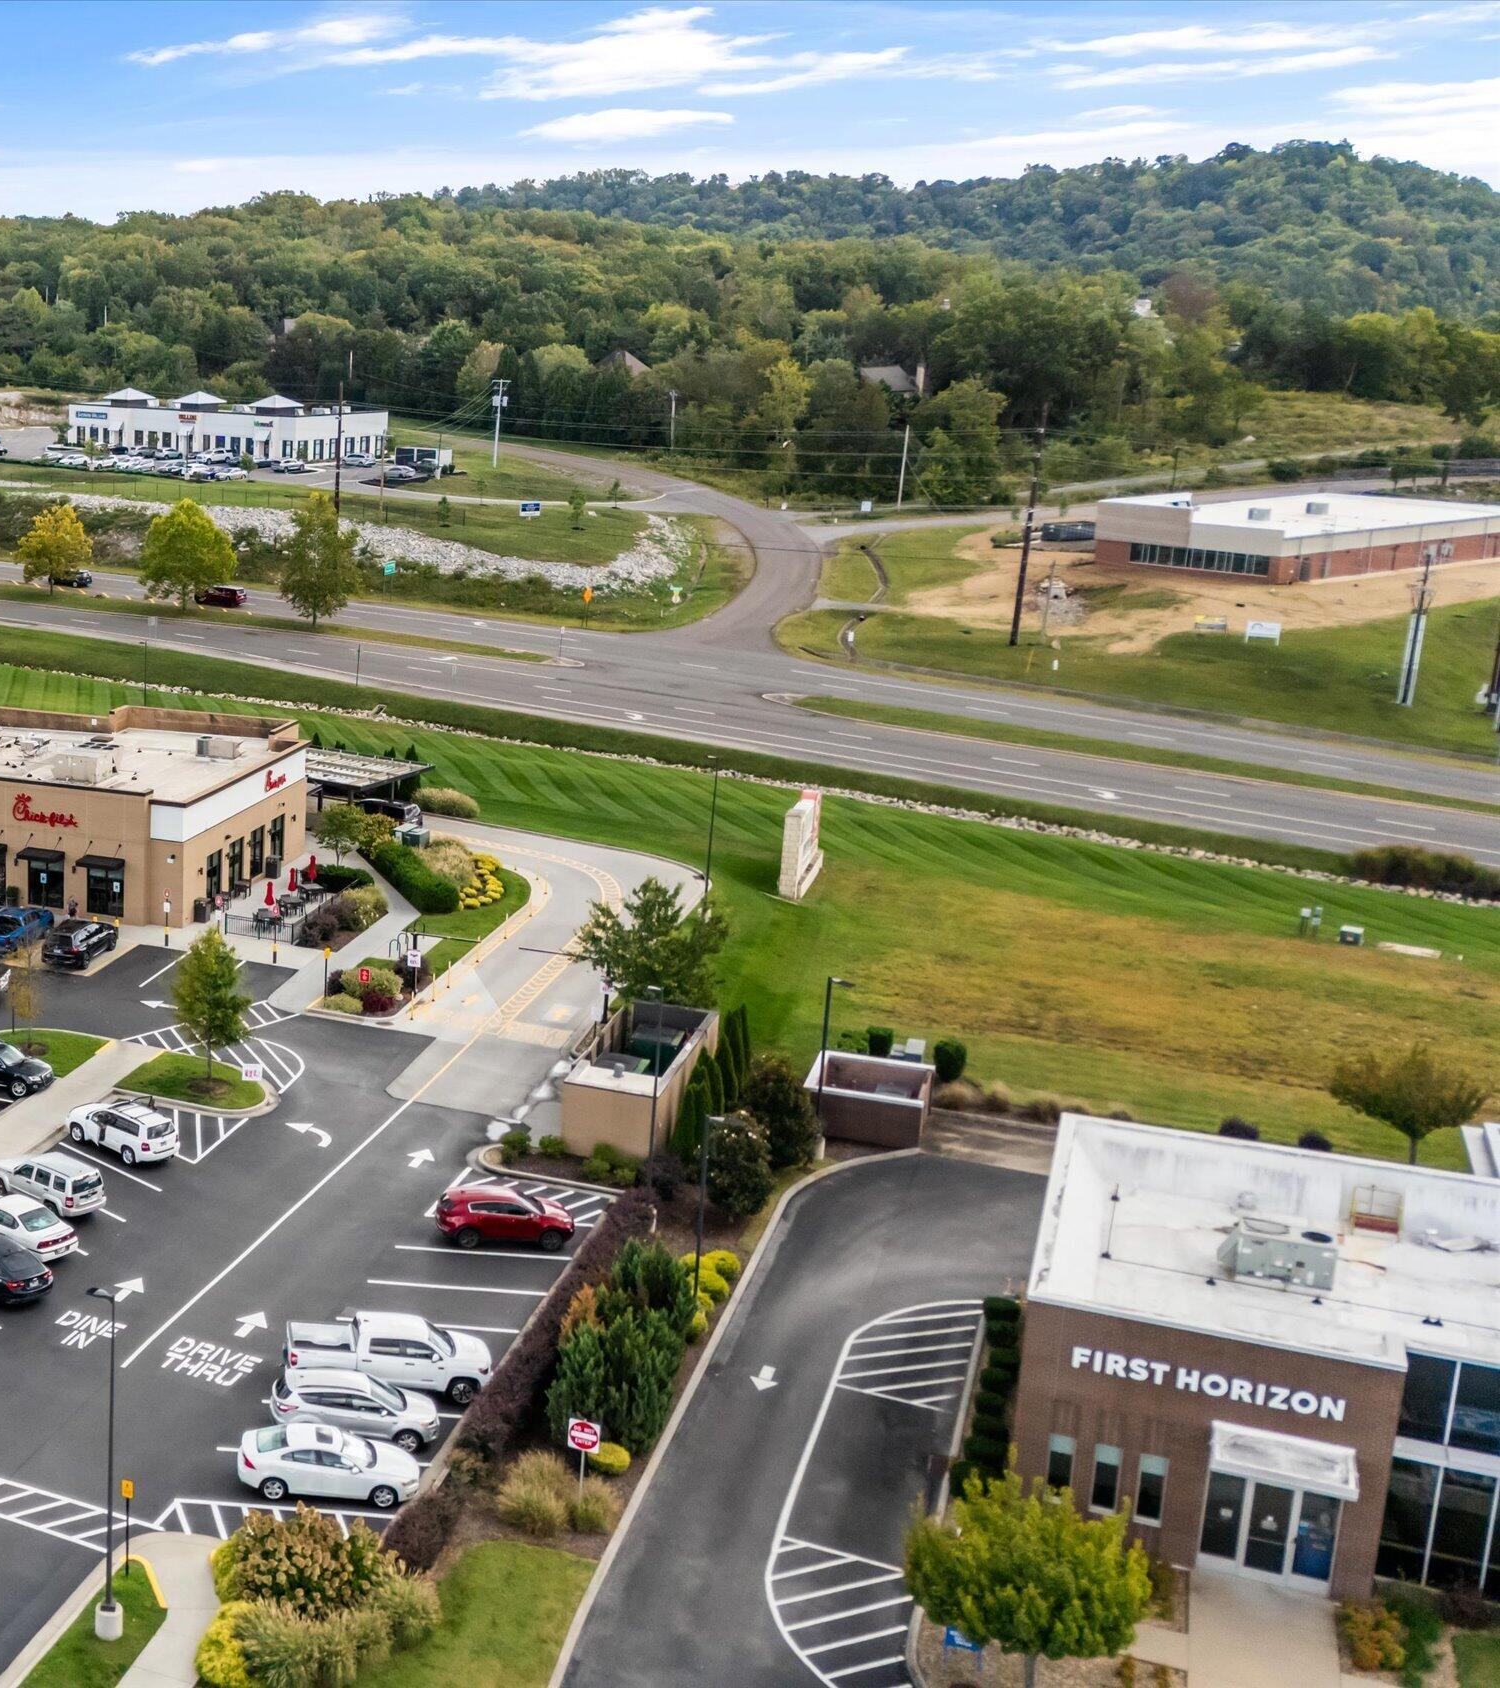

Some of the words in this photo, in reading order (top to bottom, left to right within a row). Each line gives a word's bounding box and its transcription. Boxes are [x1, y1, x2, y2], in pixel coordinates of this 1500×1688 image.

[55, 1310, 128, 1339] DINE
[60, 1329, 97, 1350] IN
[161, 1351, 244, 1387] THRU
[168, 1336, 264, 1374] DRIVE
[1071, 1346, 1171, 1386] FIRST
[1176, 1366, 1346, 1422] HORIZON
